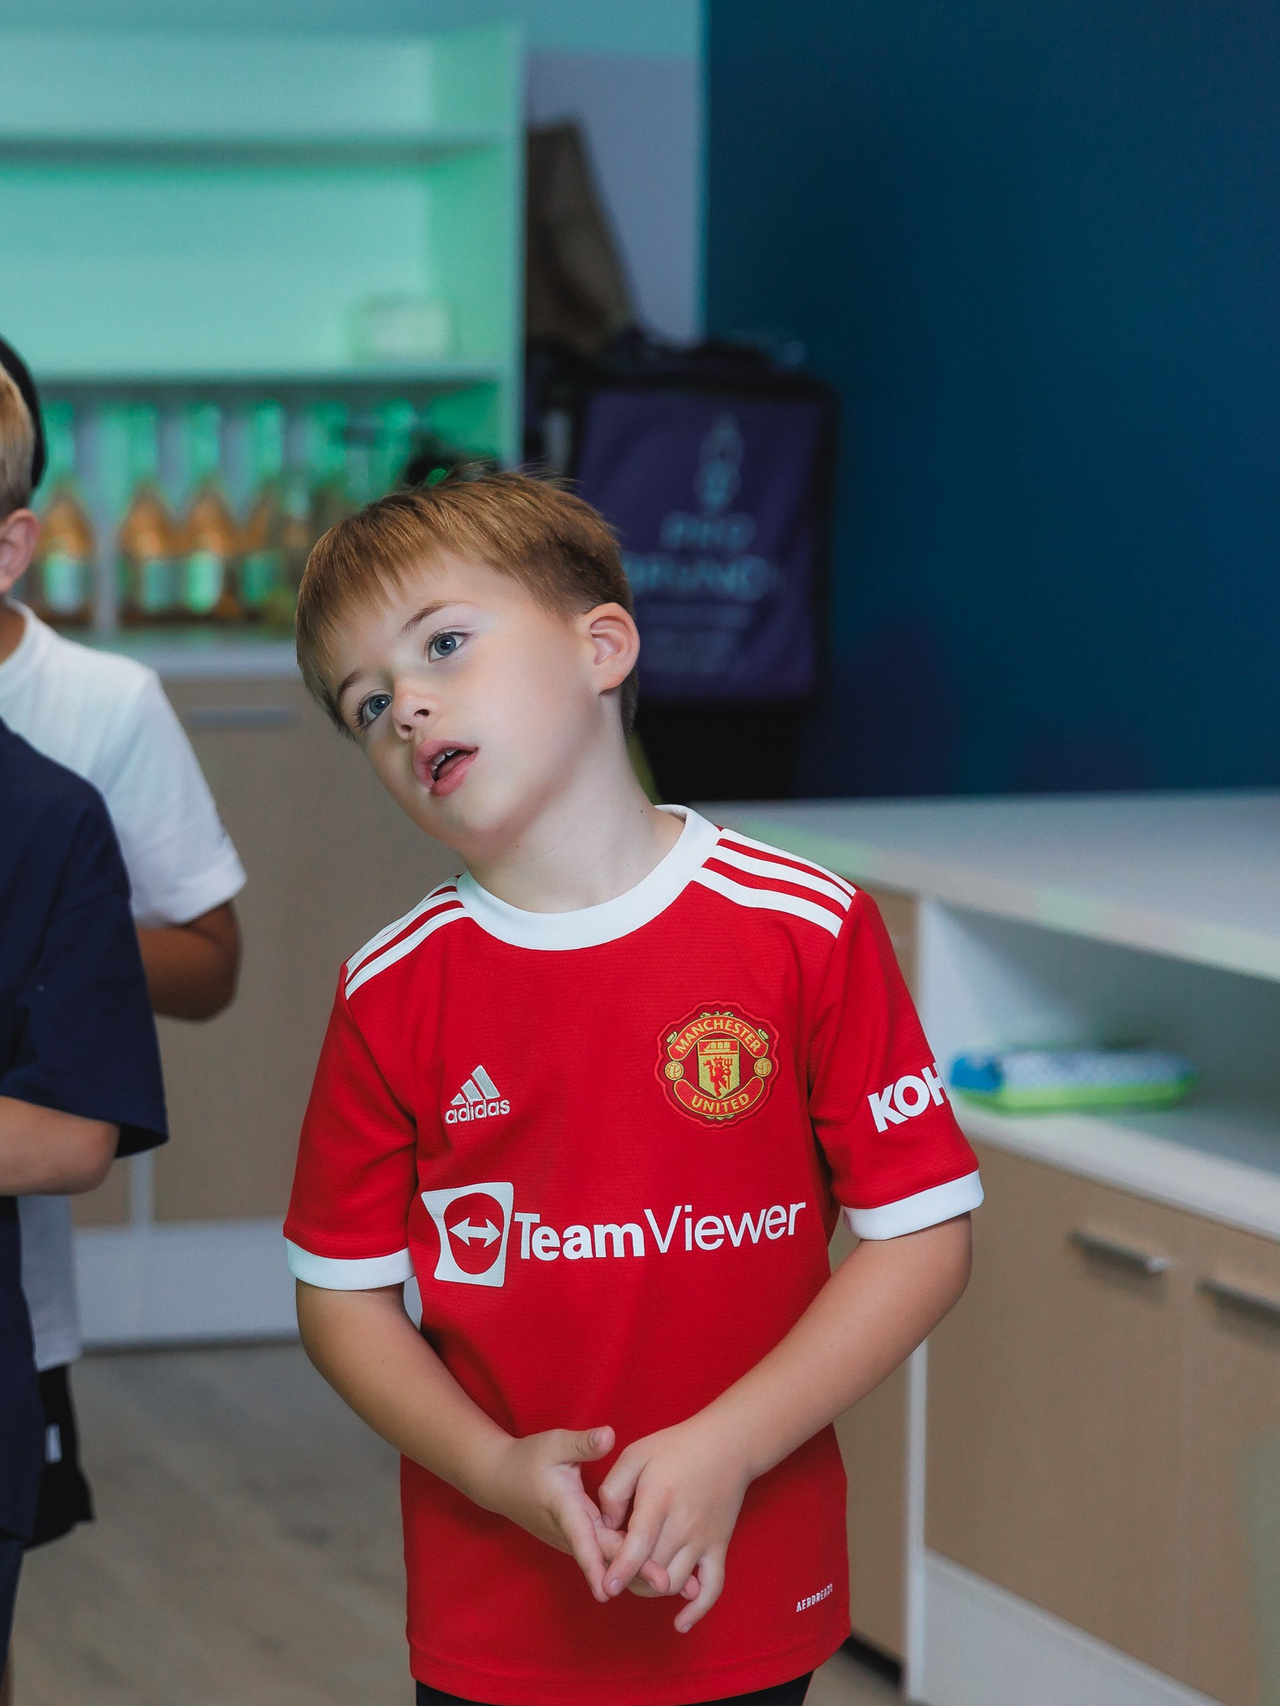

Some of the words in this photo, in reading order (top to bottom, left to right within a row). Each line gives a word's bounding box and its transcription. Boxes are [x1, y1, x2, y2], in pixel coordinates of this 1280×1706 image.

[675, 1019, 761, 1054] MANCHESTER
[445, 1099, 511, 1124] adidas
[691, 1093, 750, 1113] UNITED
[514, 1202, 806, 1261] TeamViewer
